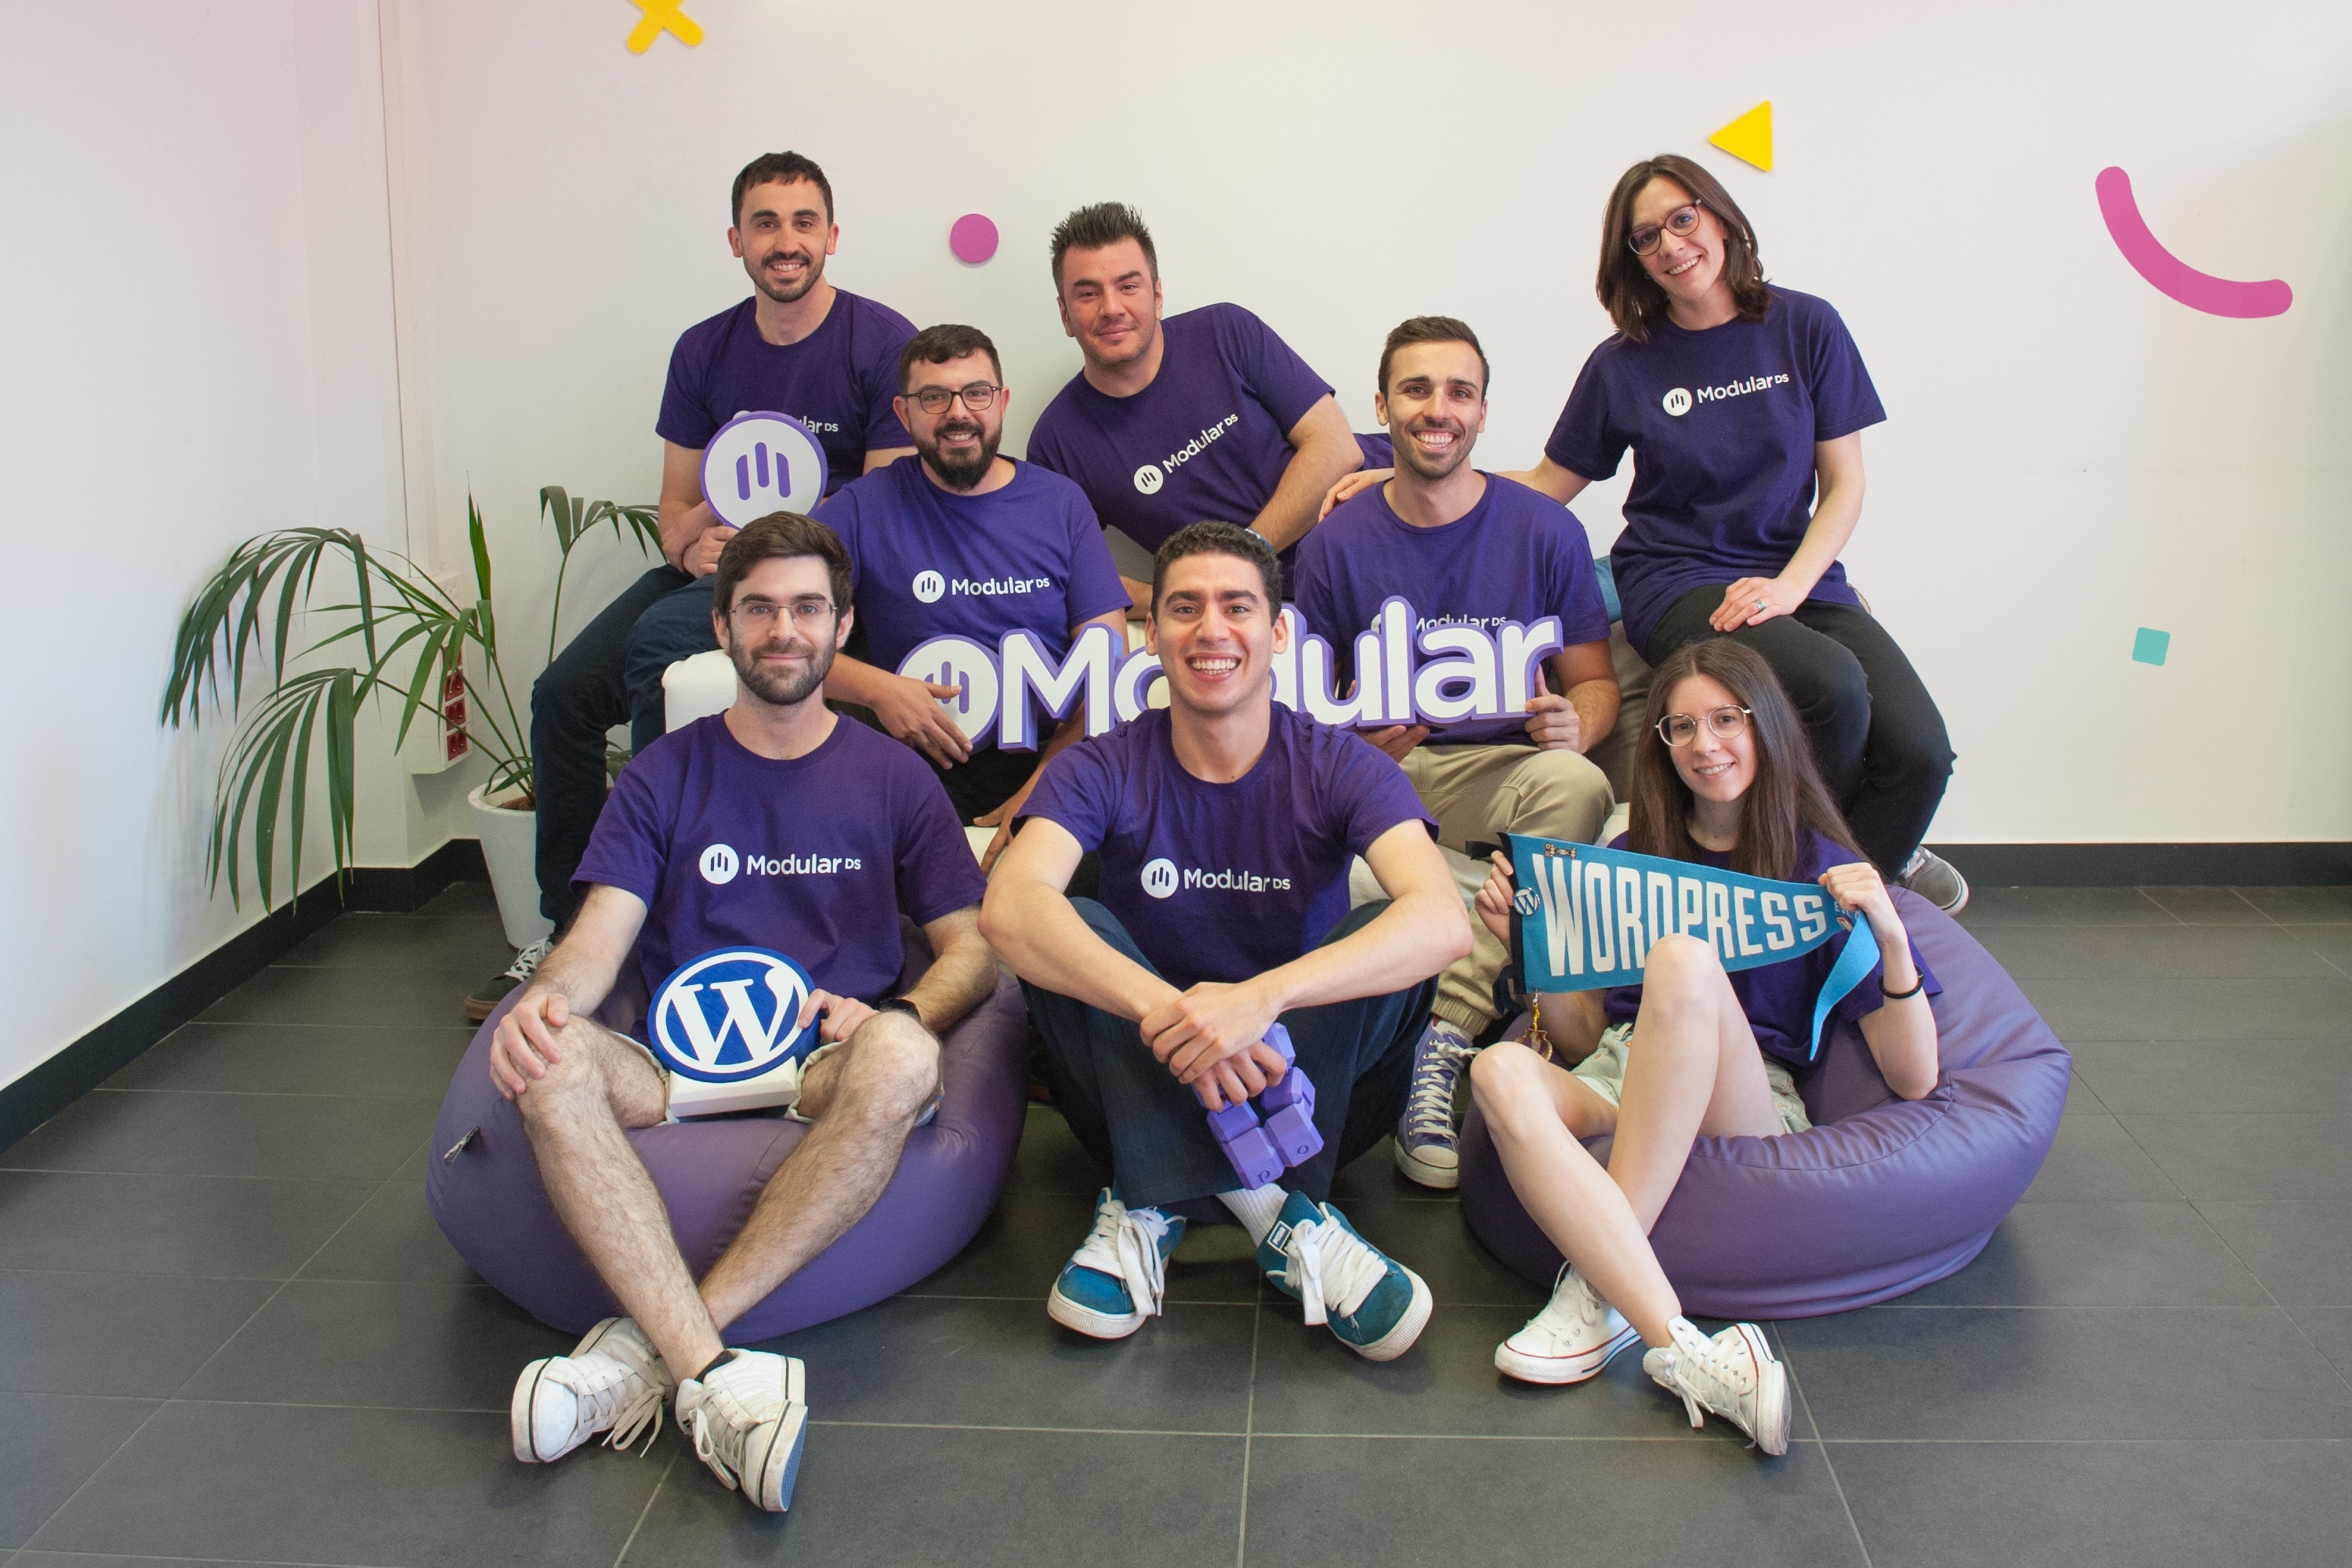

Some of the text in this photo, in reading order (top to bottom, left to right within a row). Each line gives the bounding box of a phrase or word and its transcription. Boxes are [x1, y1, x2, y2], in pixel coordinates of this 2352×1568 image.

[1697, 373, 1789, 404] Modular DS
[824, 422, 839, 432] DS
[1162, 413, 1238, 473] Modular DS
[951, 576, 1050, 596] Modular DS
[1491, 617, 1506, 627] DS
[746, 853, 861, 876] Modular DS
[1183, 868, 1291, 893] Modular DS
[1532, 853, 1827, 977] WORDPRESS
